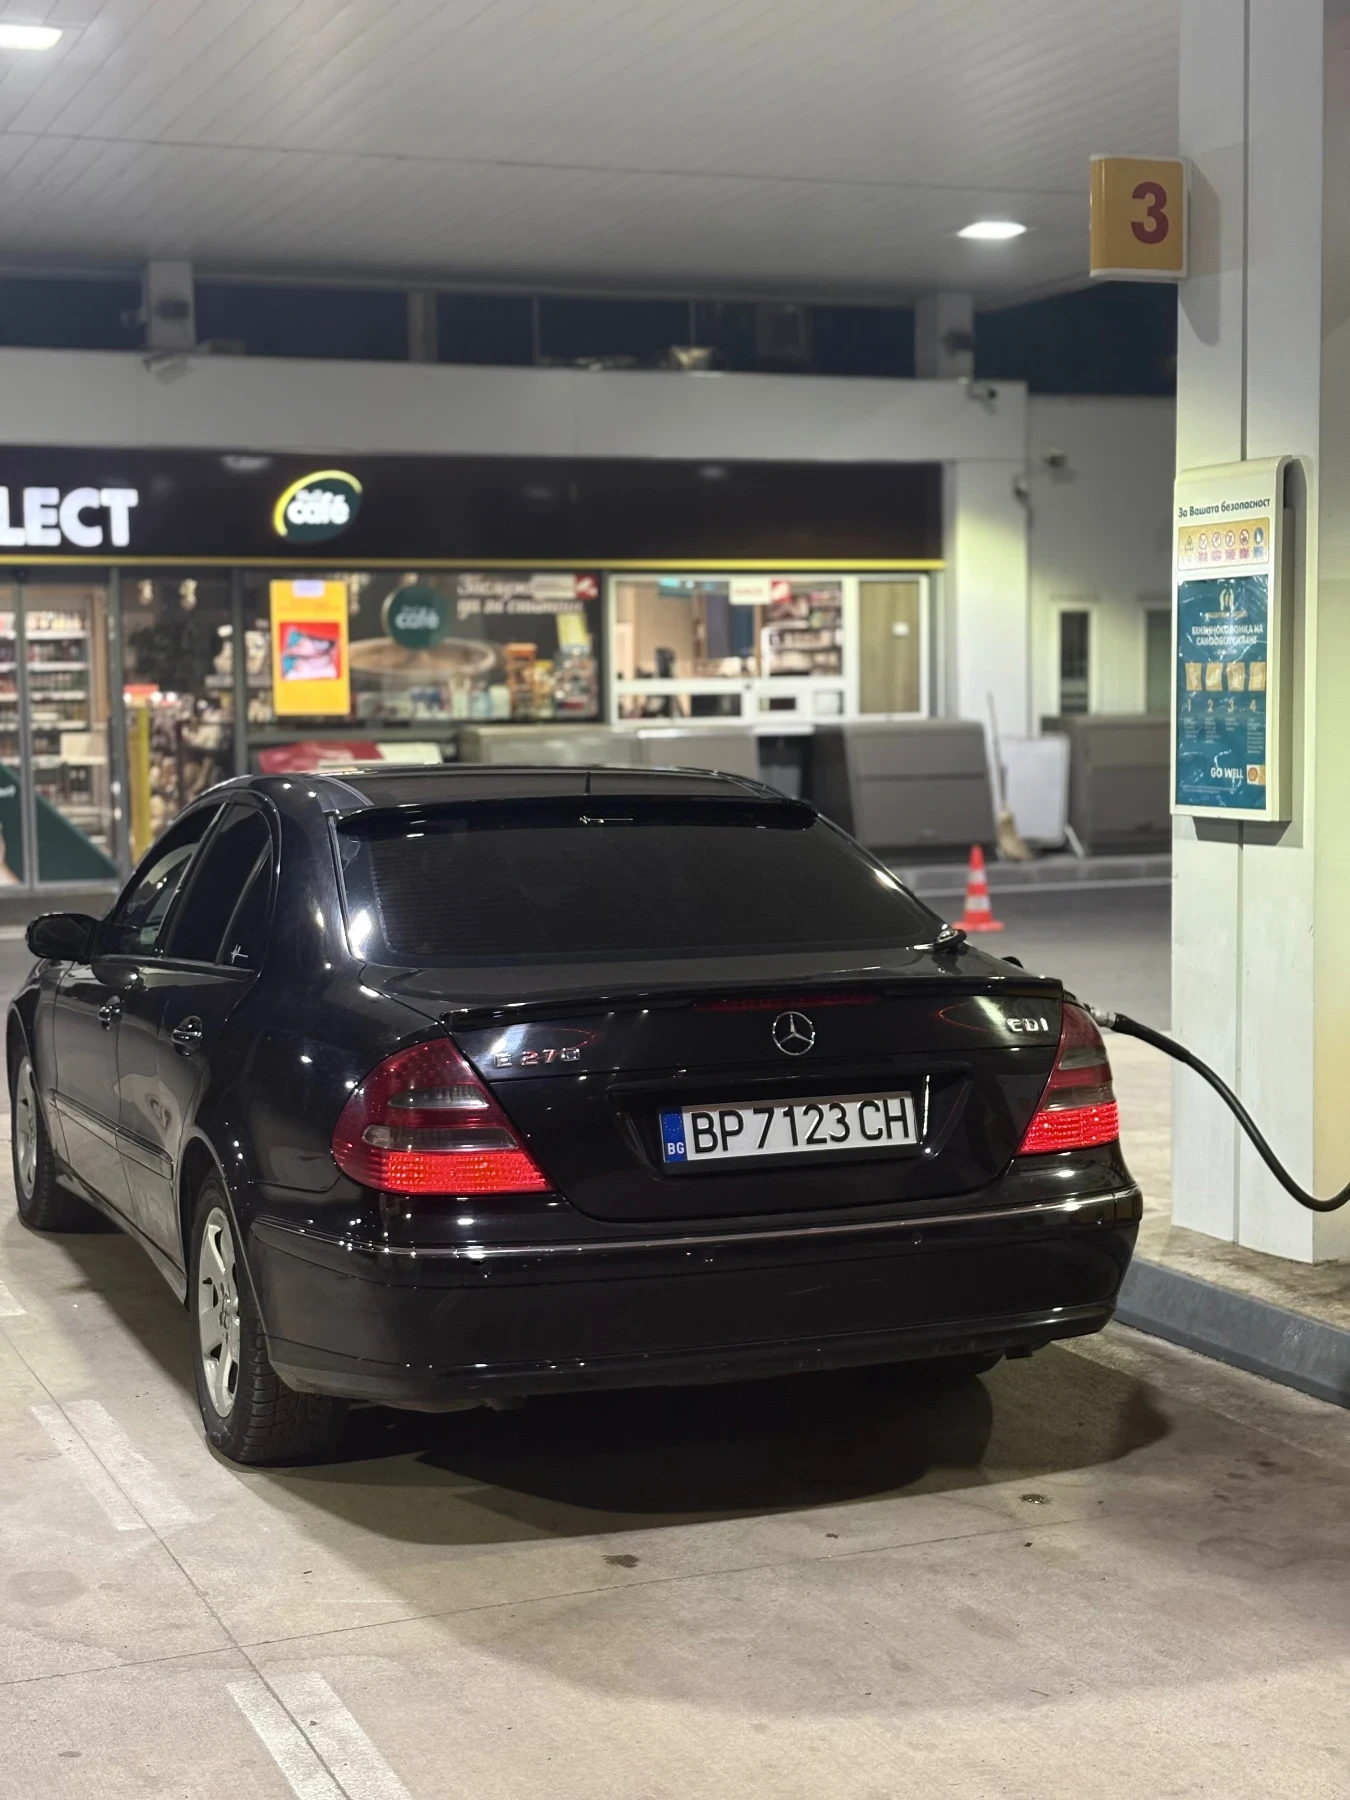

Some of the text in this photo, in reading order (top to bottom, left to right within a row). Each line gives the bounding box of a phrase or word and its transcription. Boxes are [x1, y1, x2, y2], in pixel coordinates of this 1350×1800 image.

[1131, 181, 1169, 244] 3
[1178, 498, 1270, 518] За Вашата безопасност
[0, 486, 138, 547] LECT
[1186, 699, 1192, 712] 1
[1207, 699, 1214, 713] 2
[1228, 698, 1234, 713] 3
[1249, 699, 1256, 713] 4
[1210, 767, 1243, 779] GO WELL
[1006, 1017, 1049, 1032] CDI
[494, 1047, 580, 1067] E 270
[691, 1097, 910, 1154] BP 7123 CH
[667, 1142, 685, 1155] BG
